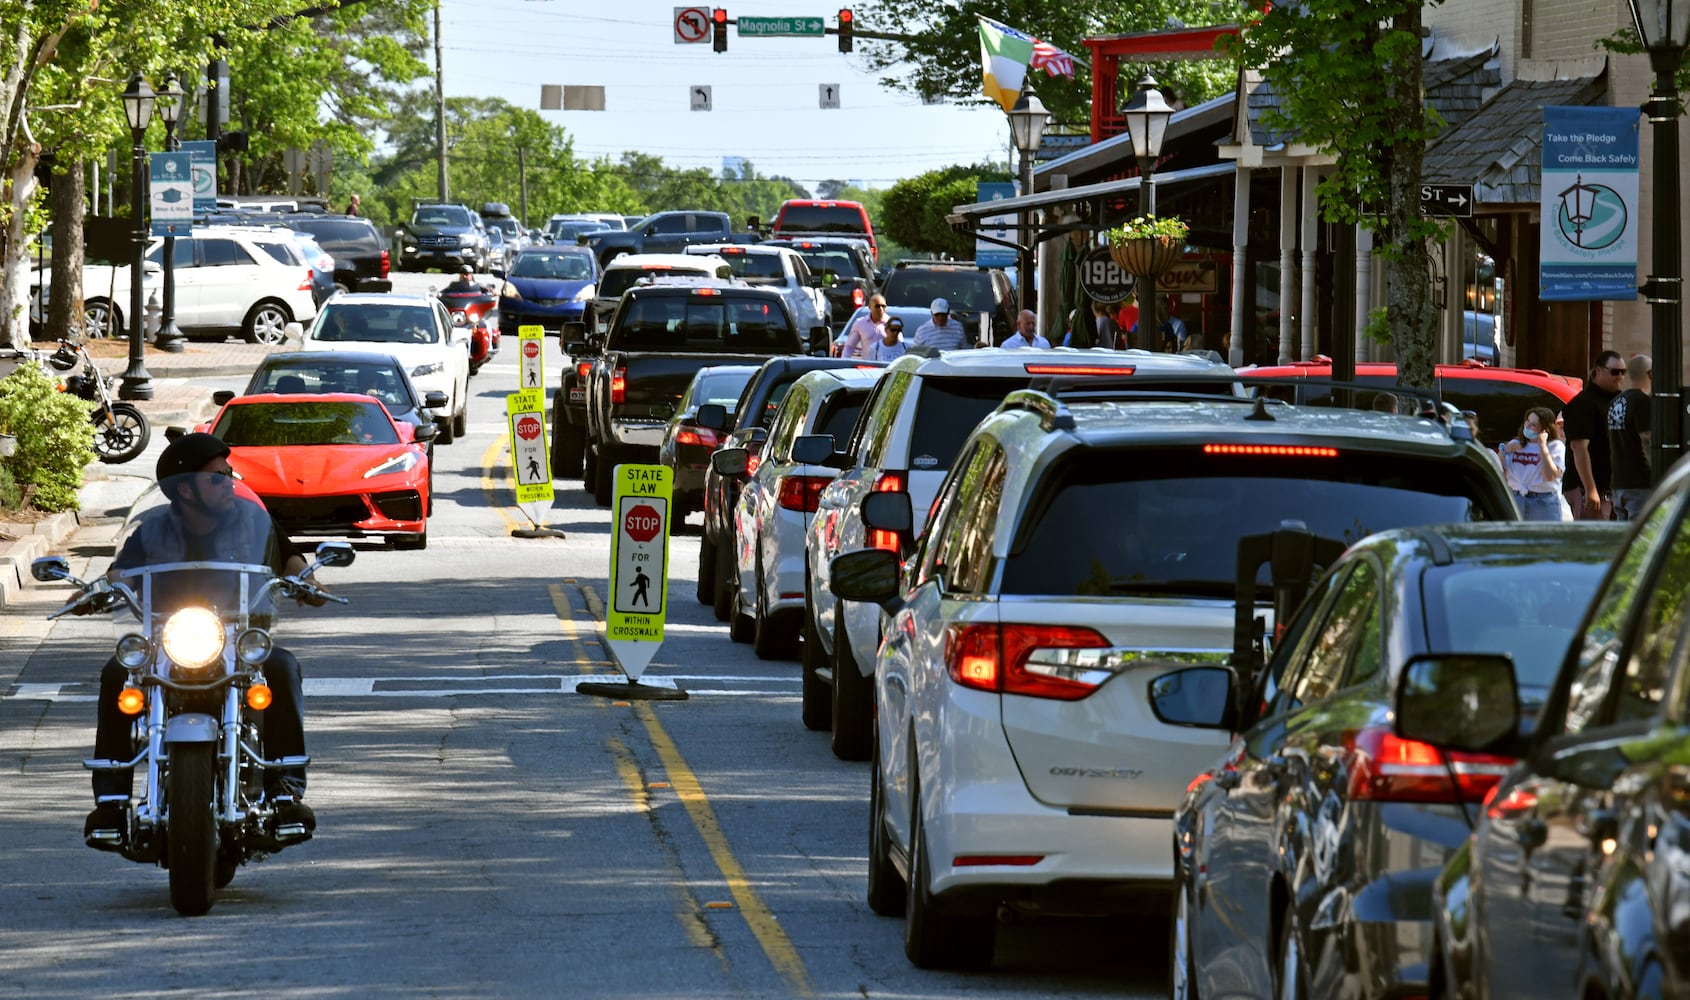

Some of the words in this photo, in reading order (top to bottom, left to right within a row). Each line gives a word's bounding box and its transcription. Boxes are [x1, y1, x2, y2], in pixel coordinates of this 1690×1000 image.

[740, 19, 790, 33] Magnolia
[795, 20, 806, 31] St
[1547, 134, 1568, 142] Take
[1570, 134, 1584, 142] the
[1586, 134, 1616, 144] Pledge
[1558, 154, 1583, 163] Come
[1585, 154, 1607, 163] Back
[1608, 154, 1636, 165] Safely
[1551, 203, 1560, 228] Come
[514, 395, 537, 404] STATE
[518, 403, 534, 412] LAW
[517, 422, 540, 434] STOP
[627, 469, 663, 481] STATE
[632, 483, 656, 494] LAW
[627, 516, 659, 531] STOP
[632, 553, 650, 562] FOR
[624, 616, 650, 625] WITHIN
[613, 625, 659, 637] CROSSWALK
[1049, 767, 1143, 778] ODYSSEY
